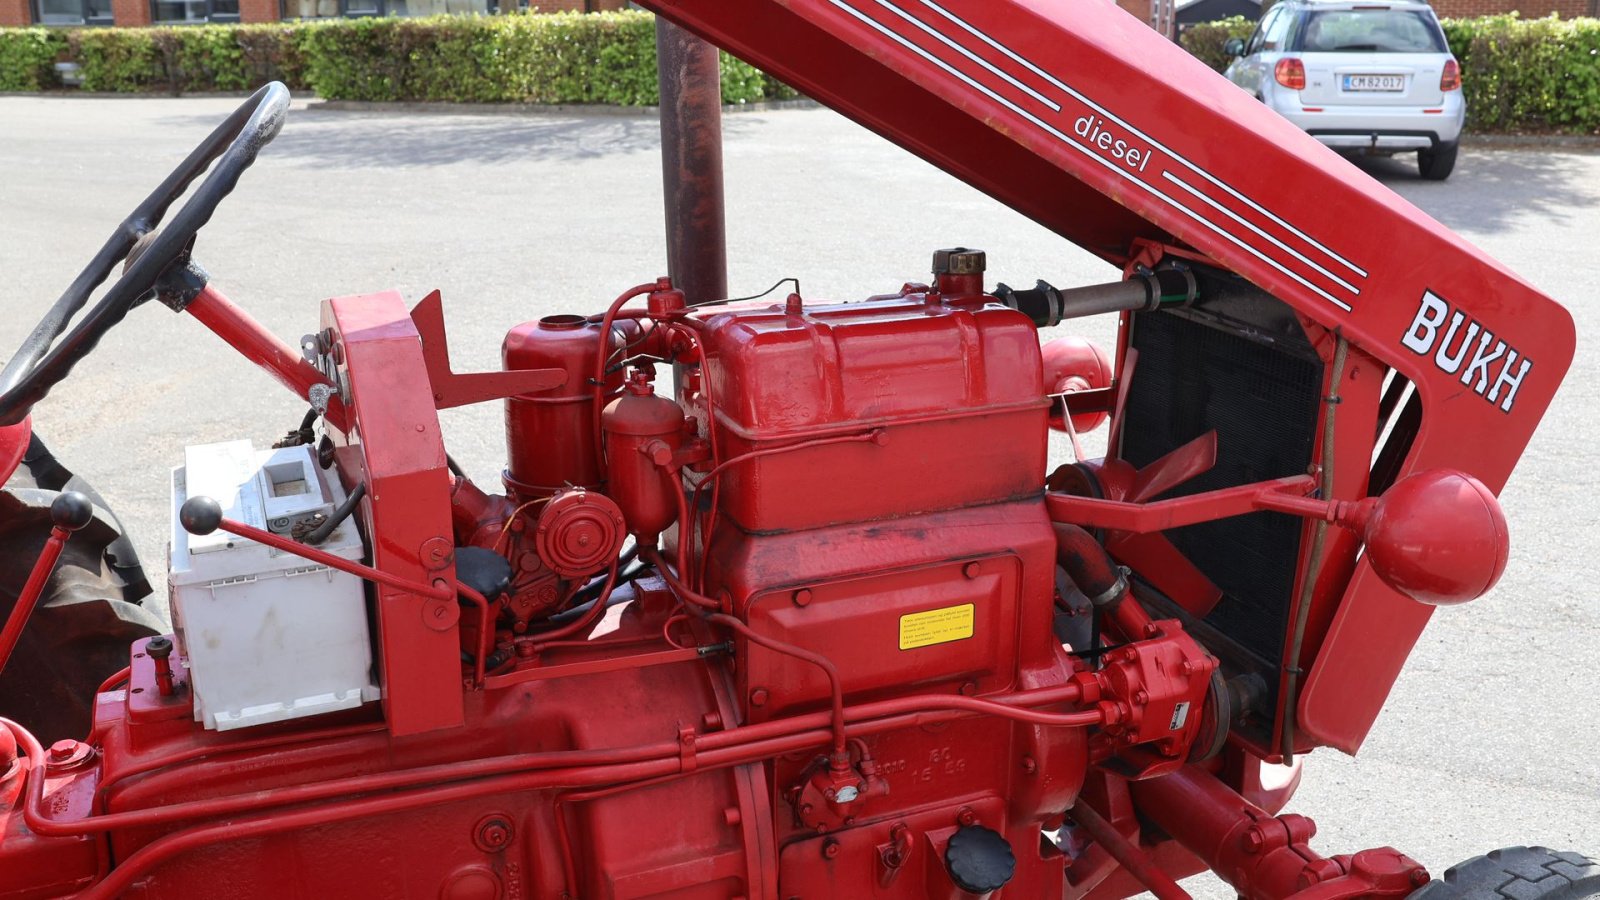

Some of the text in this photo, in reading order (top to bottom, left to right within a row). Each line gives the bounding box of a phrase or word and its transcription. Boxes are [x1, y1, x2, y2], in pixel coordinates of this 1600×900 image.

[1351, 77, 1402, 88] CM 82 017
[1074, 114, 1152, 172] diesel
[1401, 288, 1533, 414] BUKH
